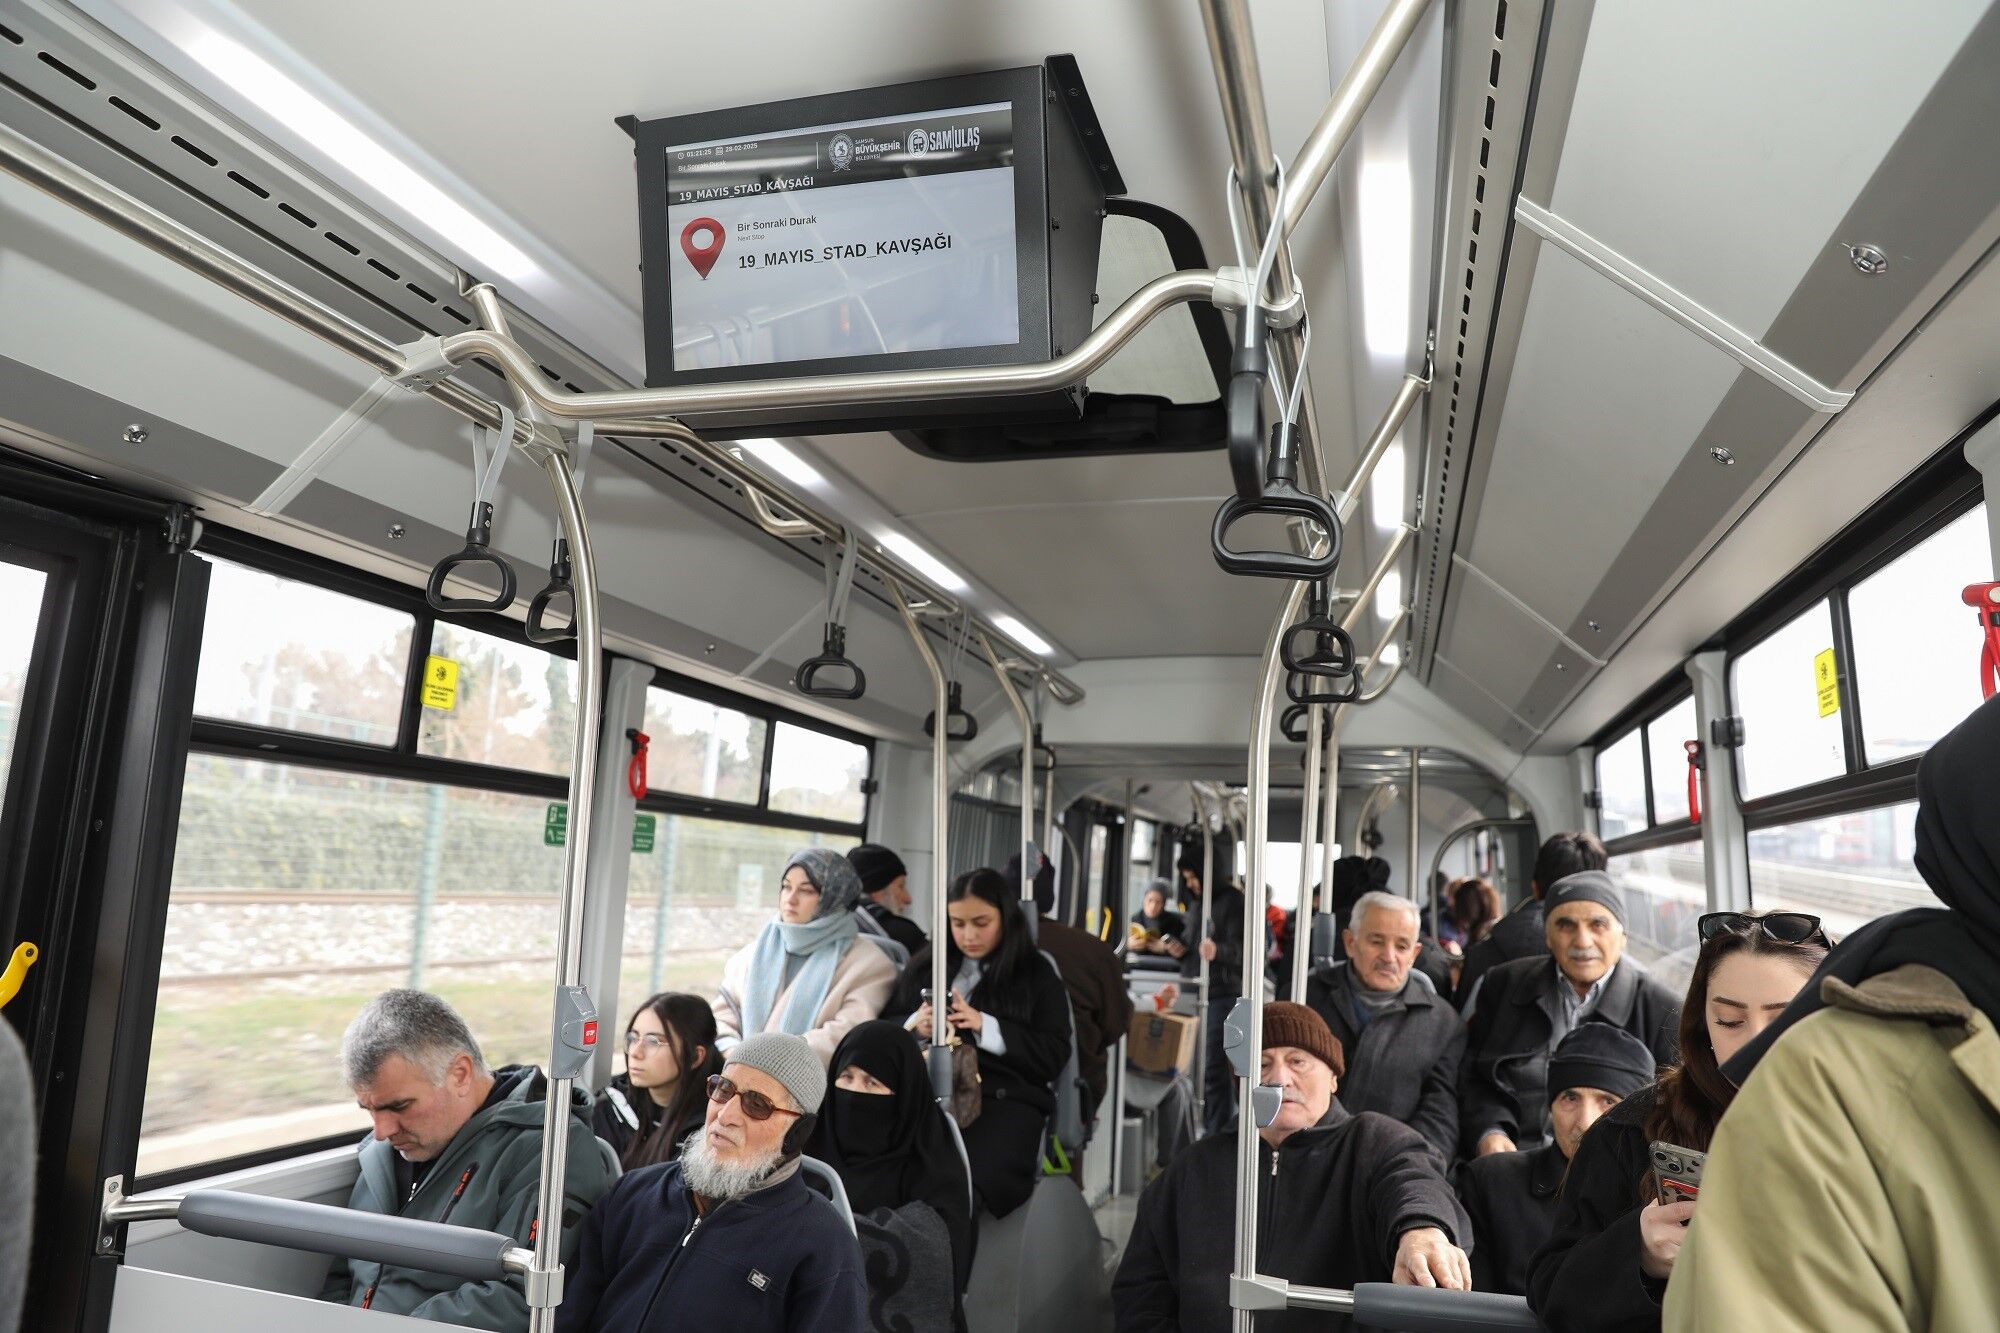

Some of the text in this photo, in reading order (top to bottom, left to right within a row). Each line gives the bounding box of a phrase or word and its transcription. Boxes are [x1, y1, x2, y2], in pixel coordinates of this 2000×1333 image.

[855, 140, 900, 155] BÜYÜKŞEHİR
[737, 215, 817, 232] Bir Sonraki Durak
[752, 233, 765, 241] Stop
[739, 233, 952, 269] 19_MAYIS_STAD_KAVŞAĞI
